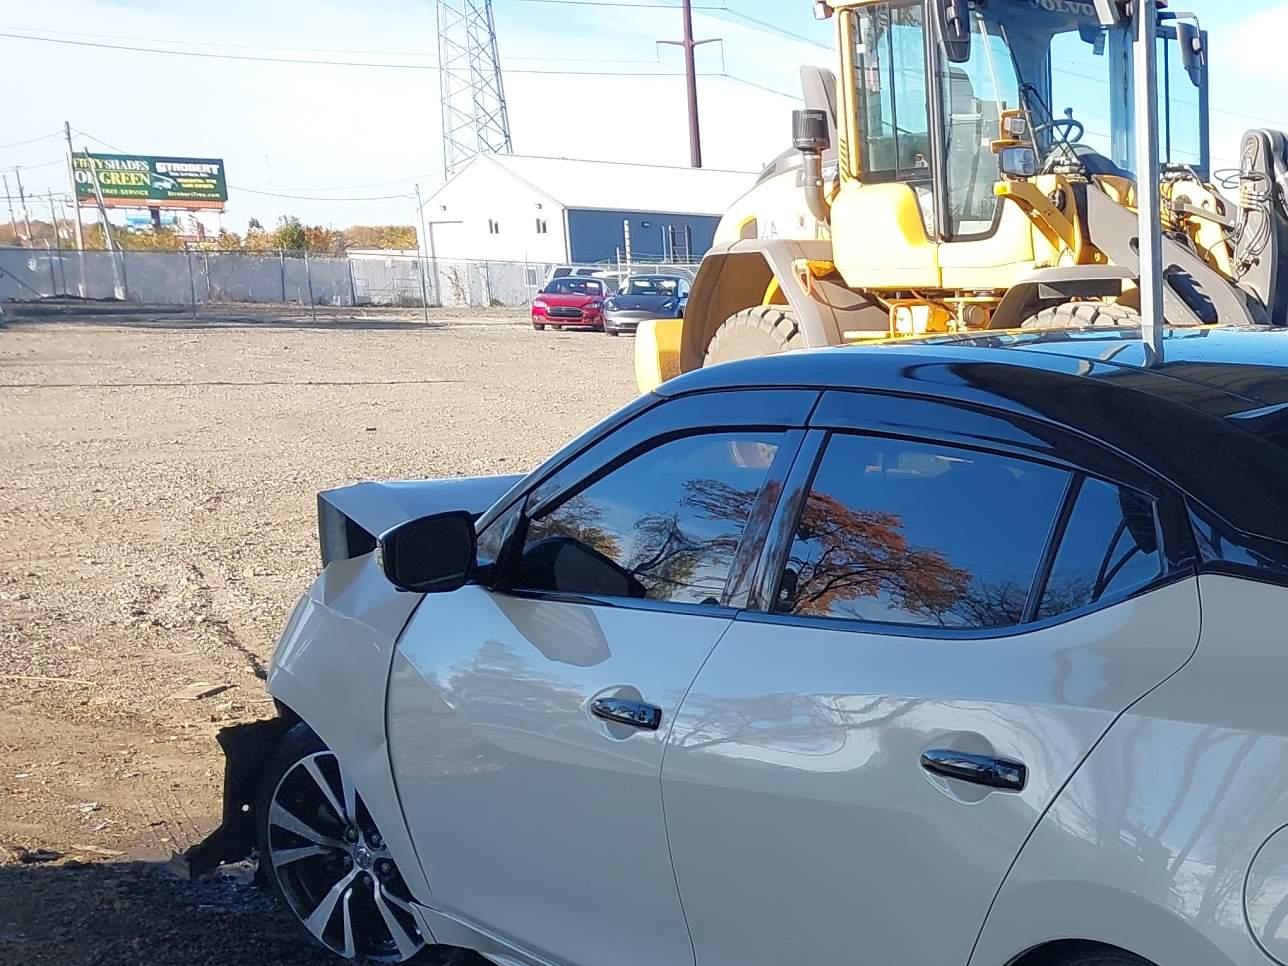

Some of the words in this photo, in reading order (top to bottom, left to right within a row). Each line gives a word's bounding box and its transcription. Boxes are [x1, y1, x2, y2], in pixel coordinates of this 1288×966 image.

[104, 159, 149, 170] SHADES
[156, 162, 219, 175] STROBERT
[99, 171, 151, 185] GREEN
